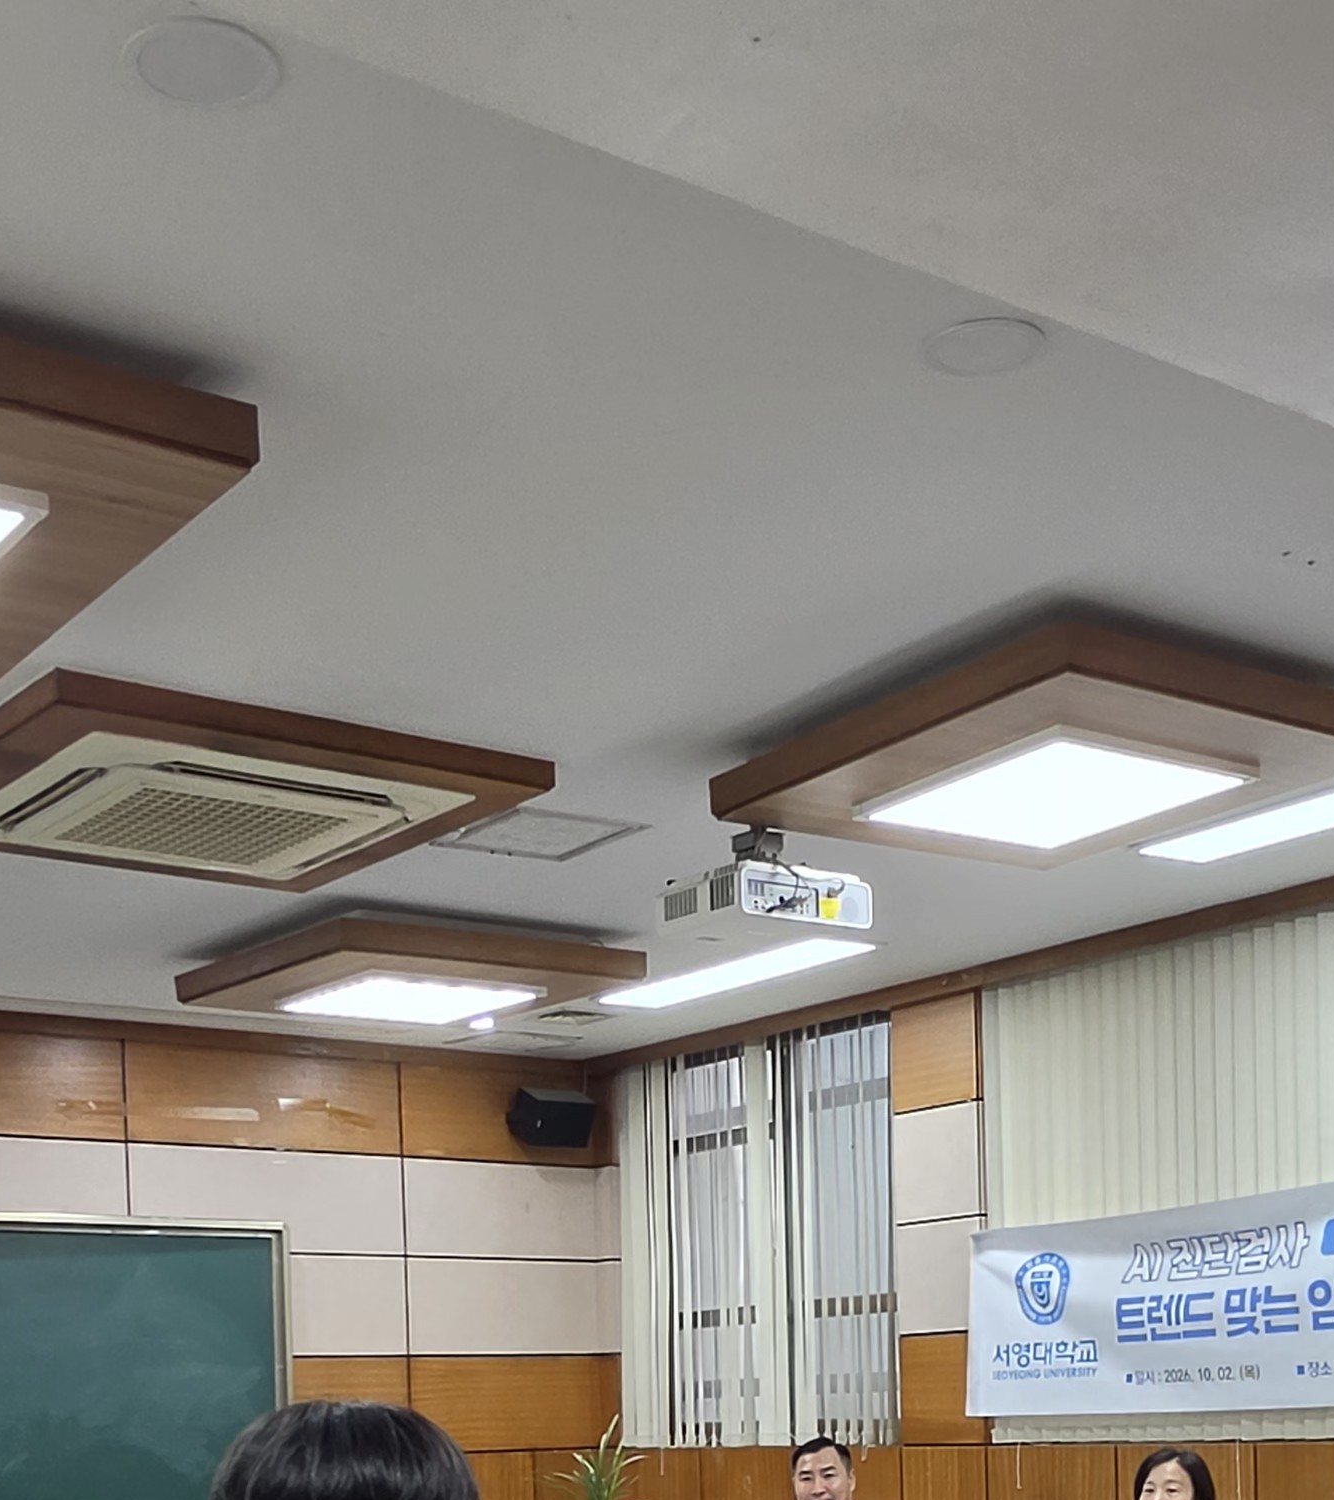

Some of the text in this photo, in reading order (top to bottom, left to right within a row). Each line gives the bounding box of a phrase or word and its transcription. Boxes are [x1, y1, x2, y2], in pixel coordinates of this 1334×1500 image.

[1121, 1221, 1311, 1284] AI 진단검사
[1115, 1290, 1217, 1343] 트렌드
[1223, 1285, 1300, 1338] 맞는
[992, 1339, 1099, 1368] 서영대학교
[992, 1367, 1098, 1381] SEOYEONG UNIVERSITY
[1307, 1361, 1333, 1378] 장소
